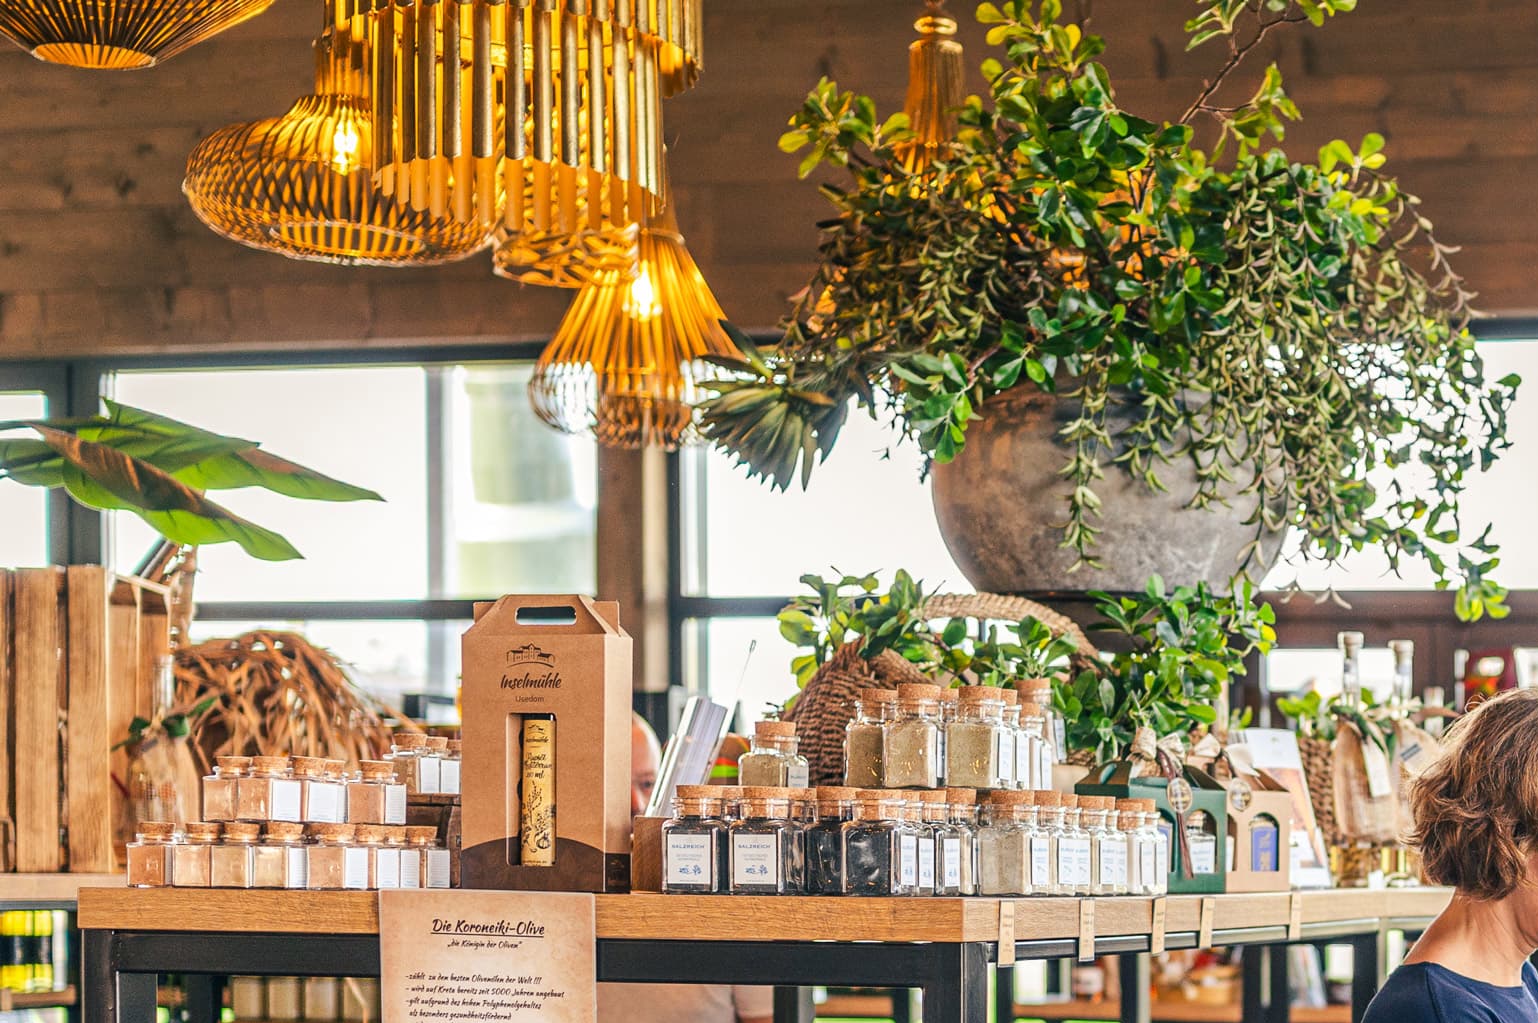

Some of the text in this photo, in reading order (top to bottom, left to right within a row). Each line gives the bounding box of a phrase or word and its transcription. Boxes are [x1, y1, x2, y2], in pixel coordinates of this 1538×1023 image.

[501, 672, 562, 690] Inselmühle
[432, 919, 544, 936] Die Koroneiki-Olive
[450, 974, 470, 982] besten
[505, 976, 515, 984] der
[438, 986, 455, 994] Kreta
[457, 987, 477, 995] bereits
[491, 988, 510, 996] 5000
[536, 990, 564, 999] angebaut
[421, 999, 449, 1008] aufgrund
